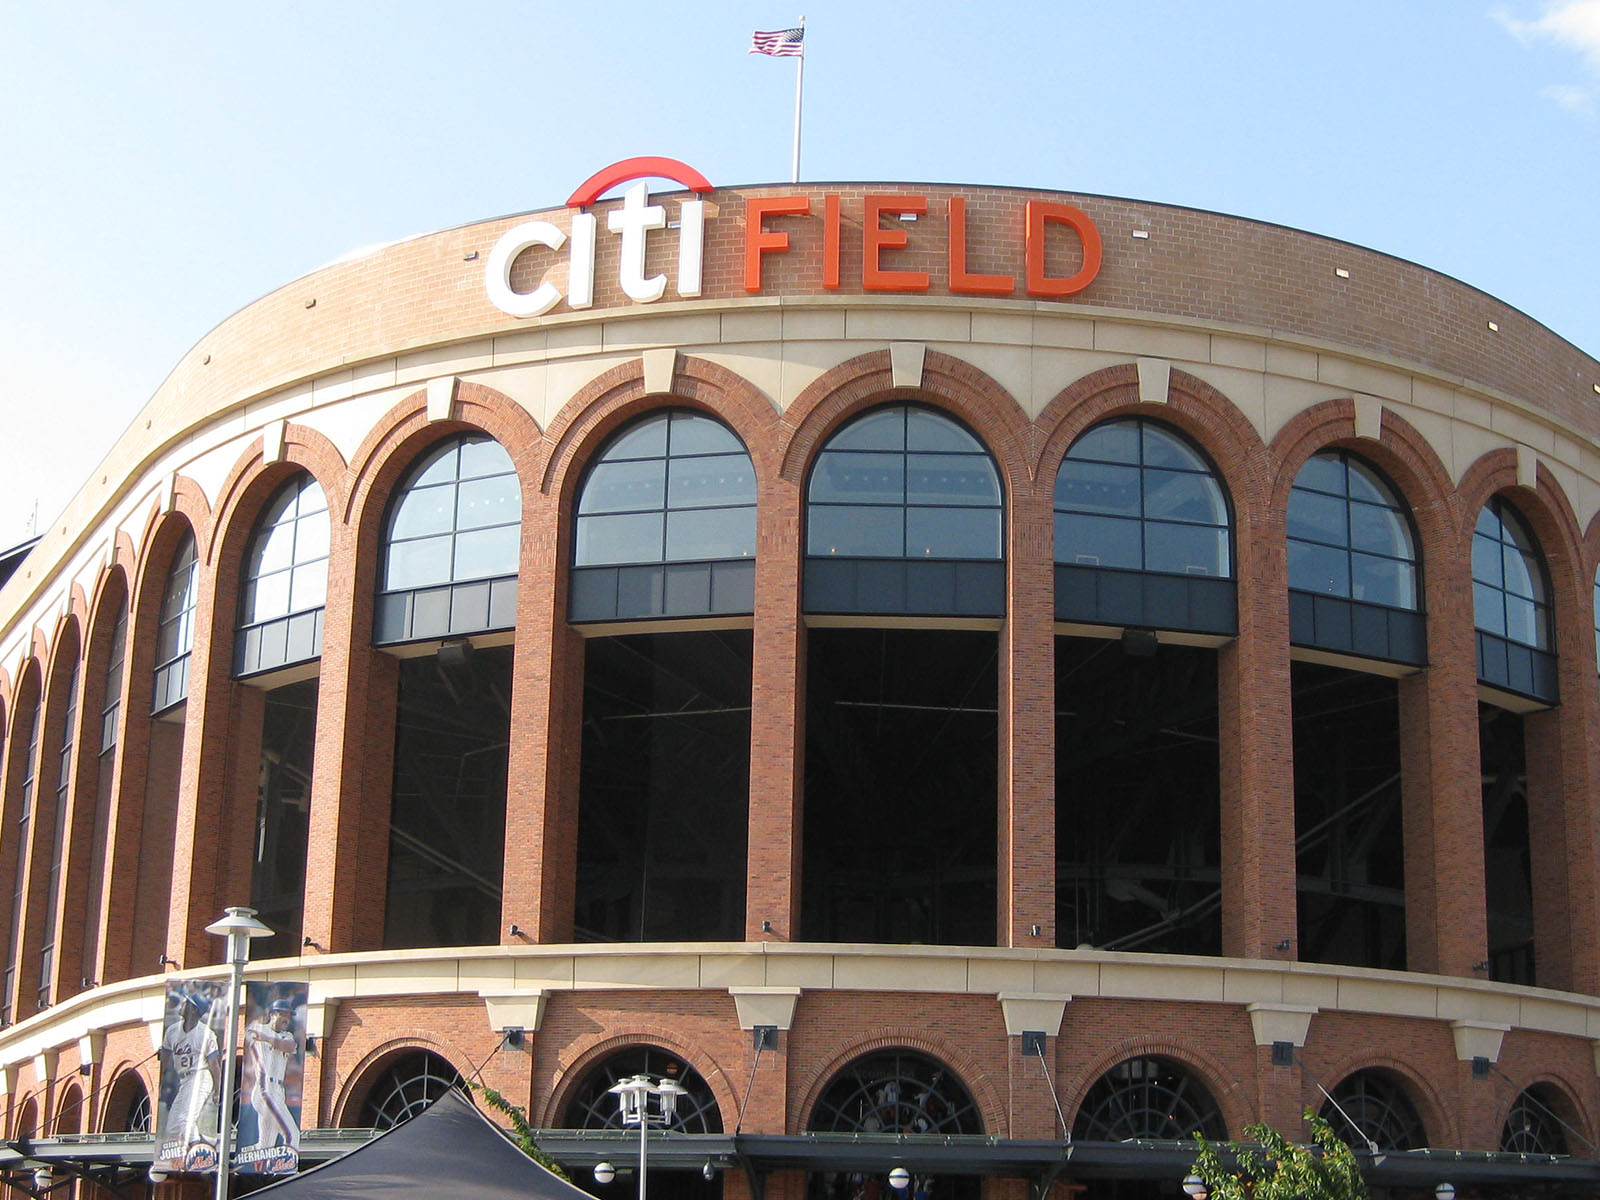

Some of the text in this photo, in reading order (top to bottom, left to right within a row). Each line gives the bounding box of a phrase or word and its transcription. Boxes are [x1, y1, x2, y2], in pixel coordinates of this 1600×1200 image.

[485, 180, 1103, 319] citi FIELD
[181, 1056, 193, 1068] 21
[160, 1145, 187, 1160] JONES
[237, 1146, 288, 1164] HERNANDEZ
